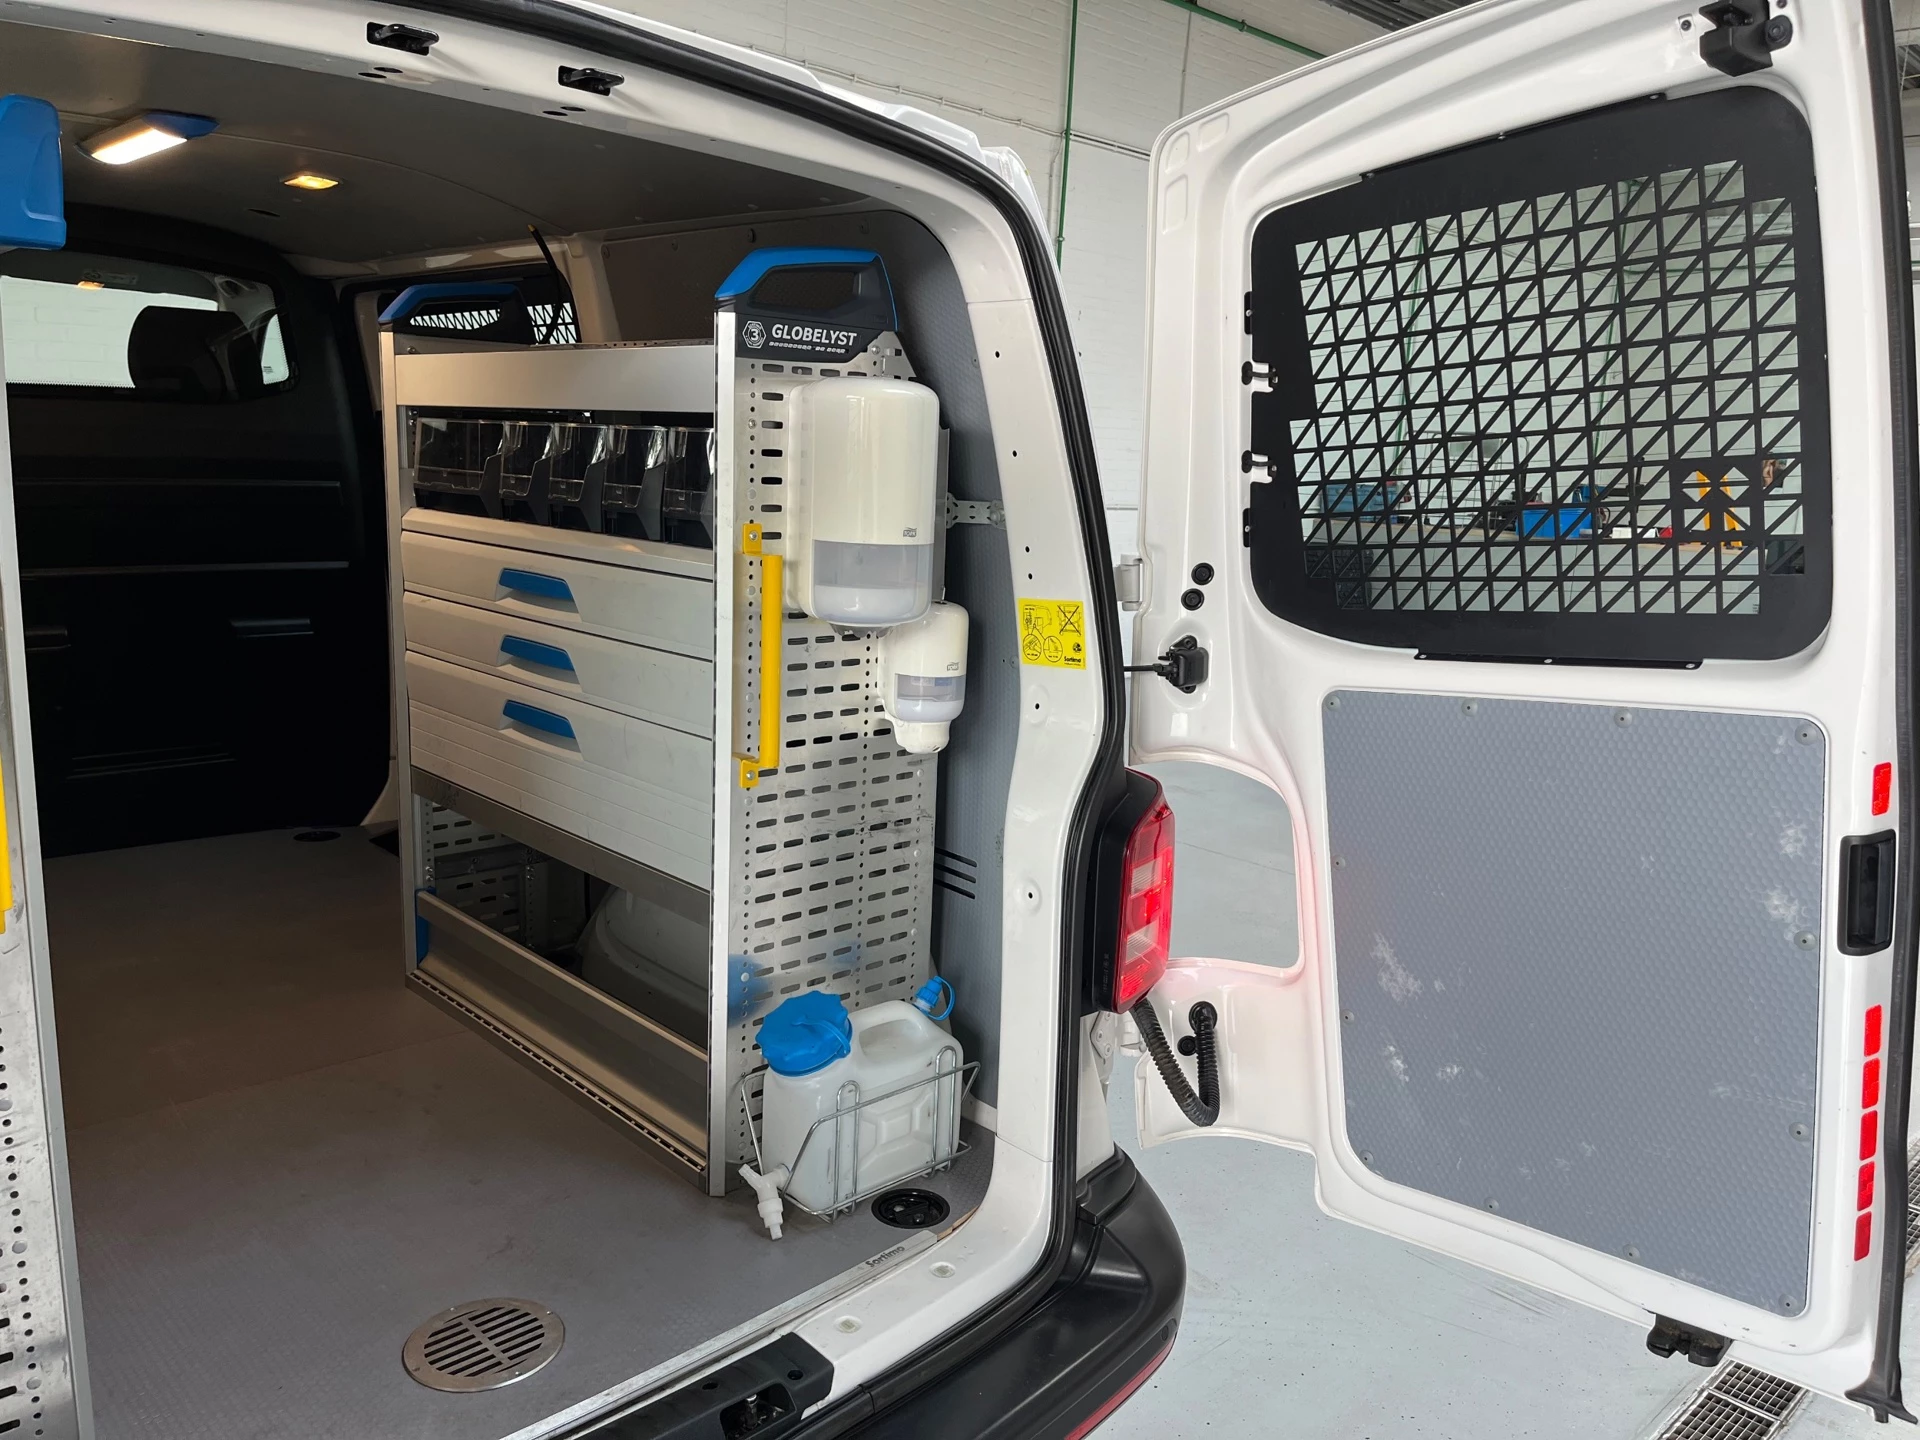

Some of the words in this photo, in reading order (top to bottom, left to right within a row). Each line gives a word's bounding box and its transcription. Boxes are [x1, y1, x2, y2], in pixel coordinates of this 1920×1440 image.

[750, 328, 760, 341] 3
[771, 323, 857, 346] GLOBELYST
[865, 1246, 905, 1267] Sortimo
